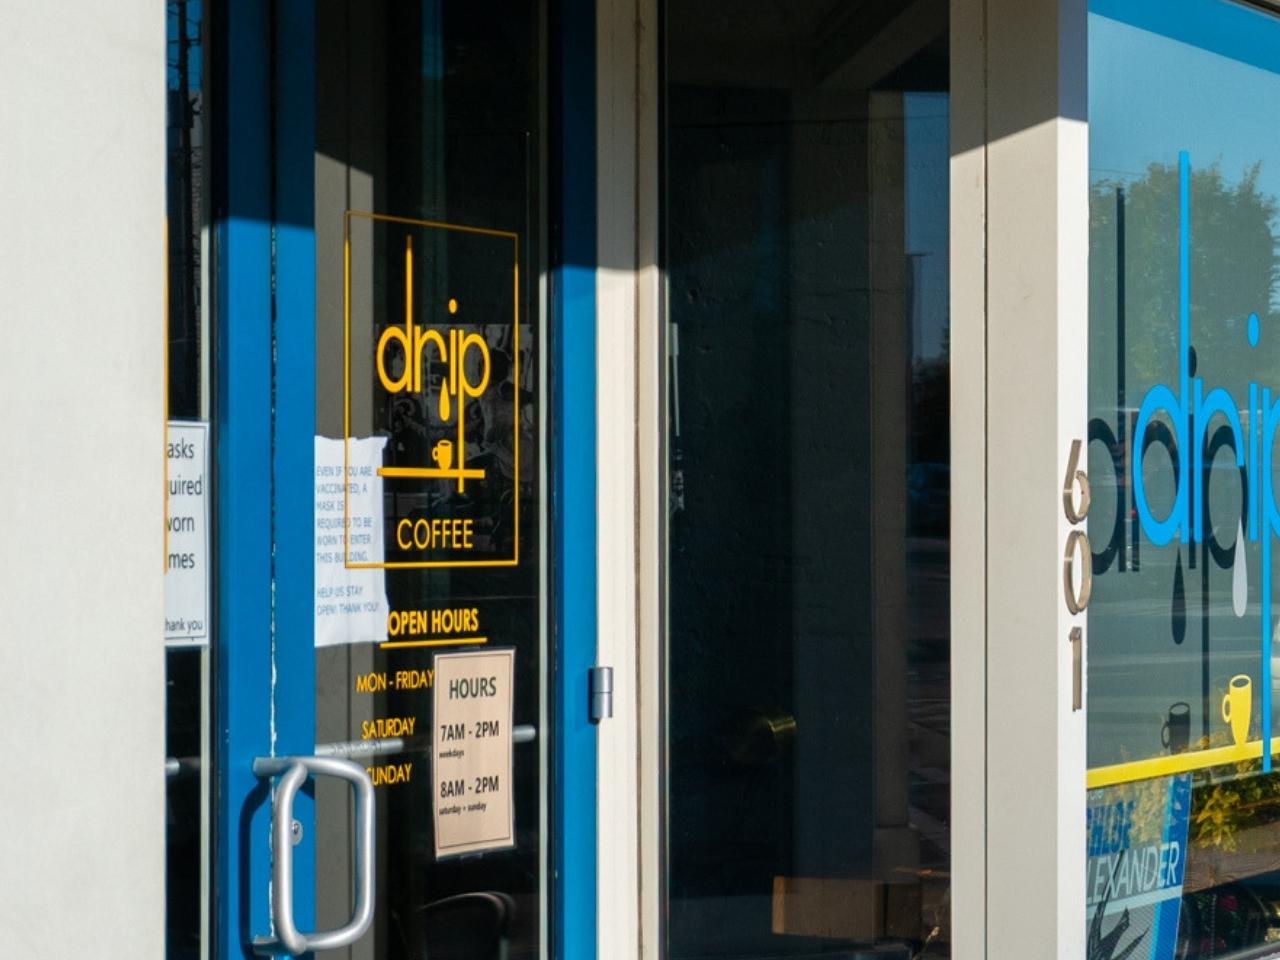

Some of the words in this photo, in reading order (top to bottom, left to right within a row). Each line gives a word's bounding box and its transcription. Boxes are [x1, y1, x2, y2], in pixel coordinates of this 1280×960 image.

[376, 235, 491, 493] drip
[166, 437, 195, 460] asks
[316, 466, 334, 477] EVEN
[335, 466, 342, 477] IF
[344, 466, 358, 477] OU
[360, 466, 373, 476] ARE
[166, 474, 203, 497] uired
[316, 483, 360, 495] VACCINAED,
[362, 483, 368, 493] A
[316, 501, 335, 511] MASK
[336, 501, 344, 511] IS
[352, 517, 361, 527] TO
[363, 517, 373, 527] BE
[317, 535, 337, 545] WORN
[339, 535, 349, 545] T
[350, 534, 371, 544] ENTER
[397, 518, 474, 550] COFFEE
[167, 551, 196, 570] mes
[316, 552, 332, 563] THIS
[1063, 439, 1092, 712] 601
[336, 587, 345, 597] US
[346, 585, 363, 597] STAY
[339, 602, 361, 614] THANK
[165, 617, 185, 632] hank
[186, 618, 203, 636] you
[387, 611, 427, 636] OPEN
[431, 608, 479, 634] HOURS
[356, 672, 387, 693] MON
[396, 669, 435, 690] FRIDAY
[449, 676, 497, 700] HOURS
[361, 716, 416, 741] SATURDAY
[440, 723, 465, 742] 7AM
[475, 720, 500, 738] 2PM
[439, 749, 465, 760] weekdays
[440, 780, 465, 798] 8AM
[475, 776, 500, 794] 2PM
[467, 802, 487, 813] sunday
